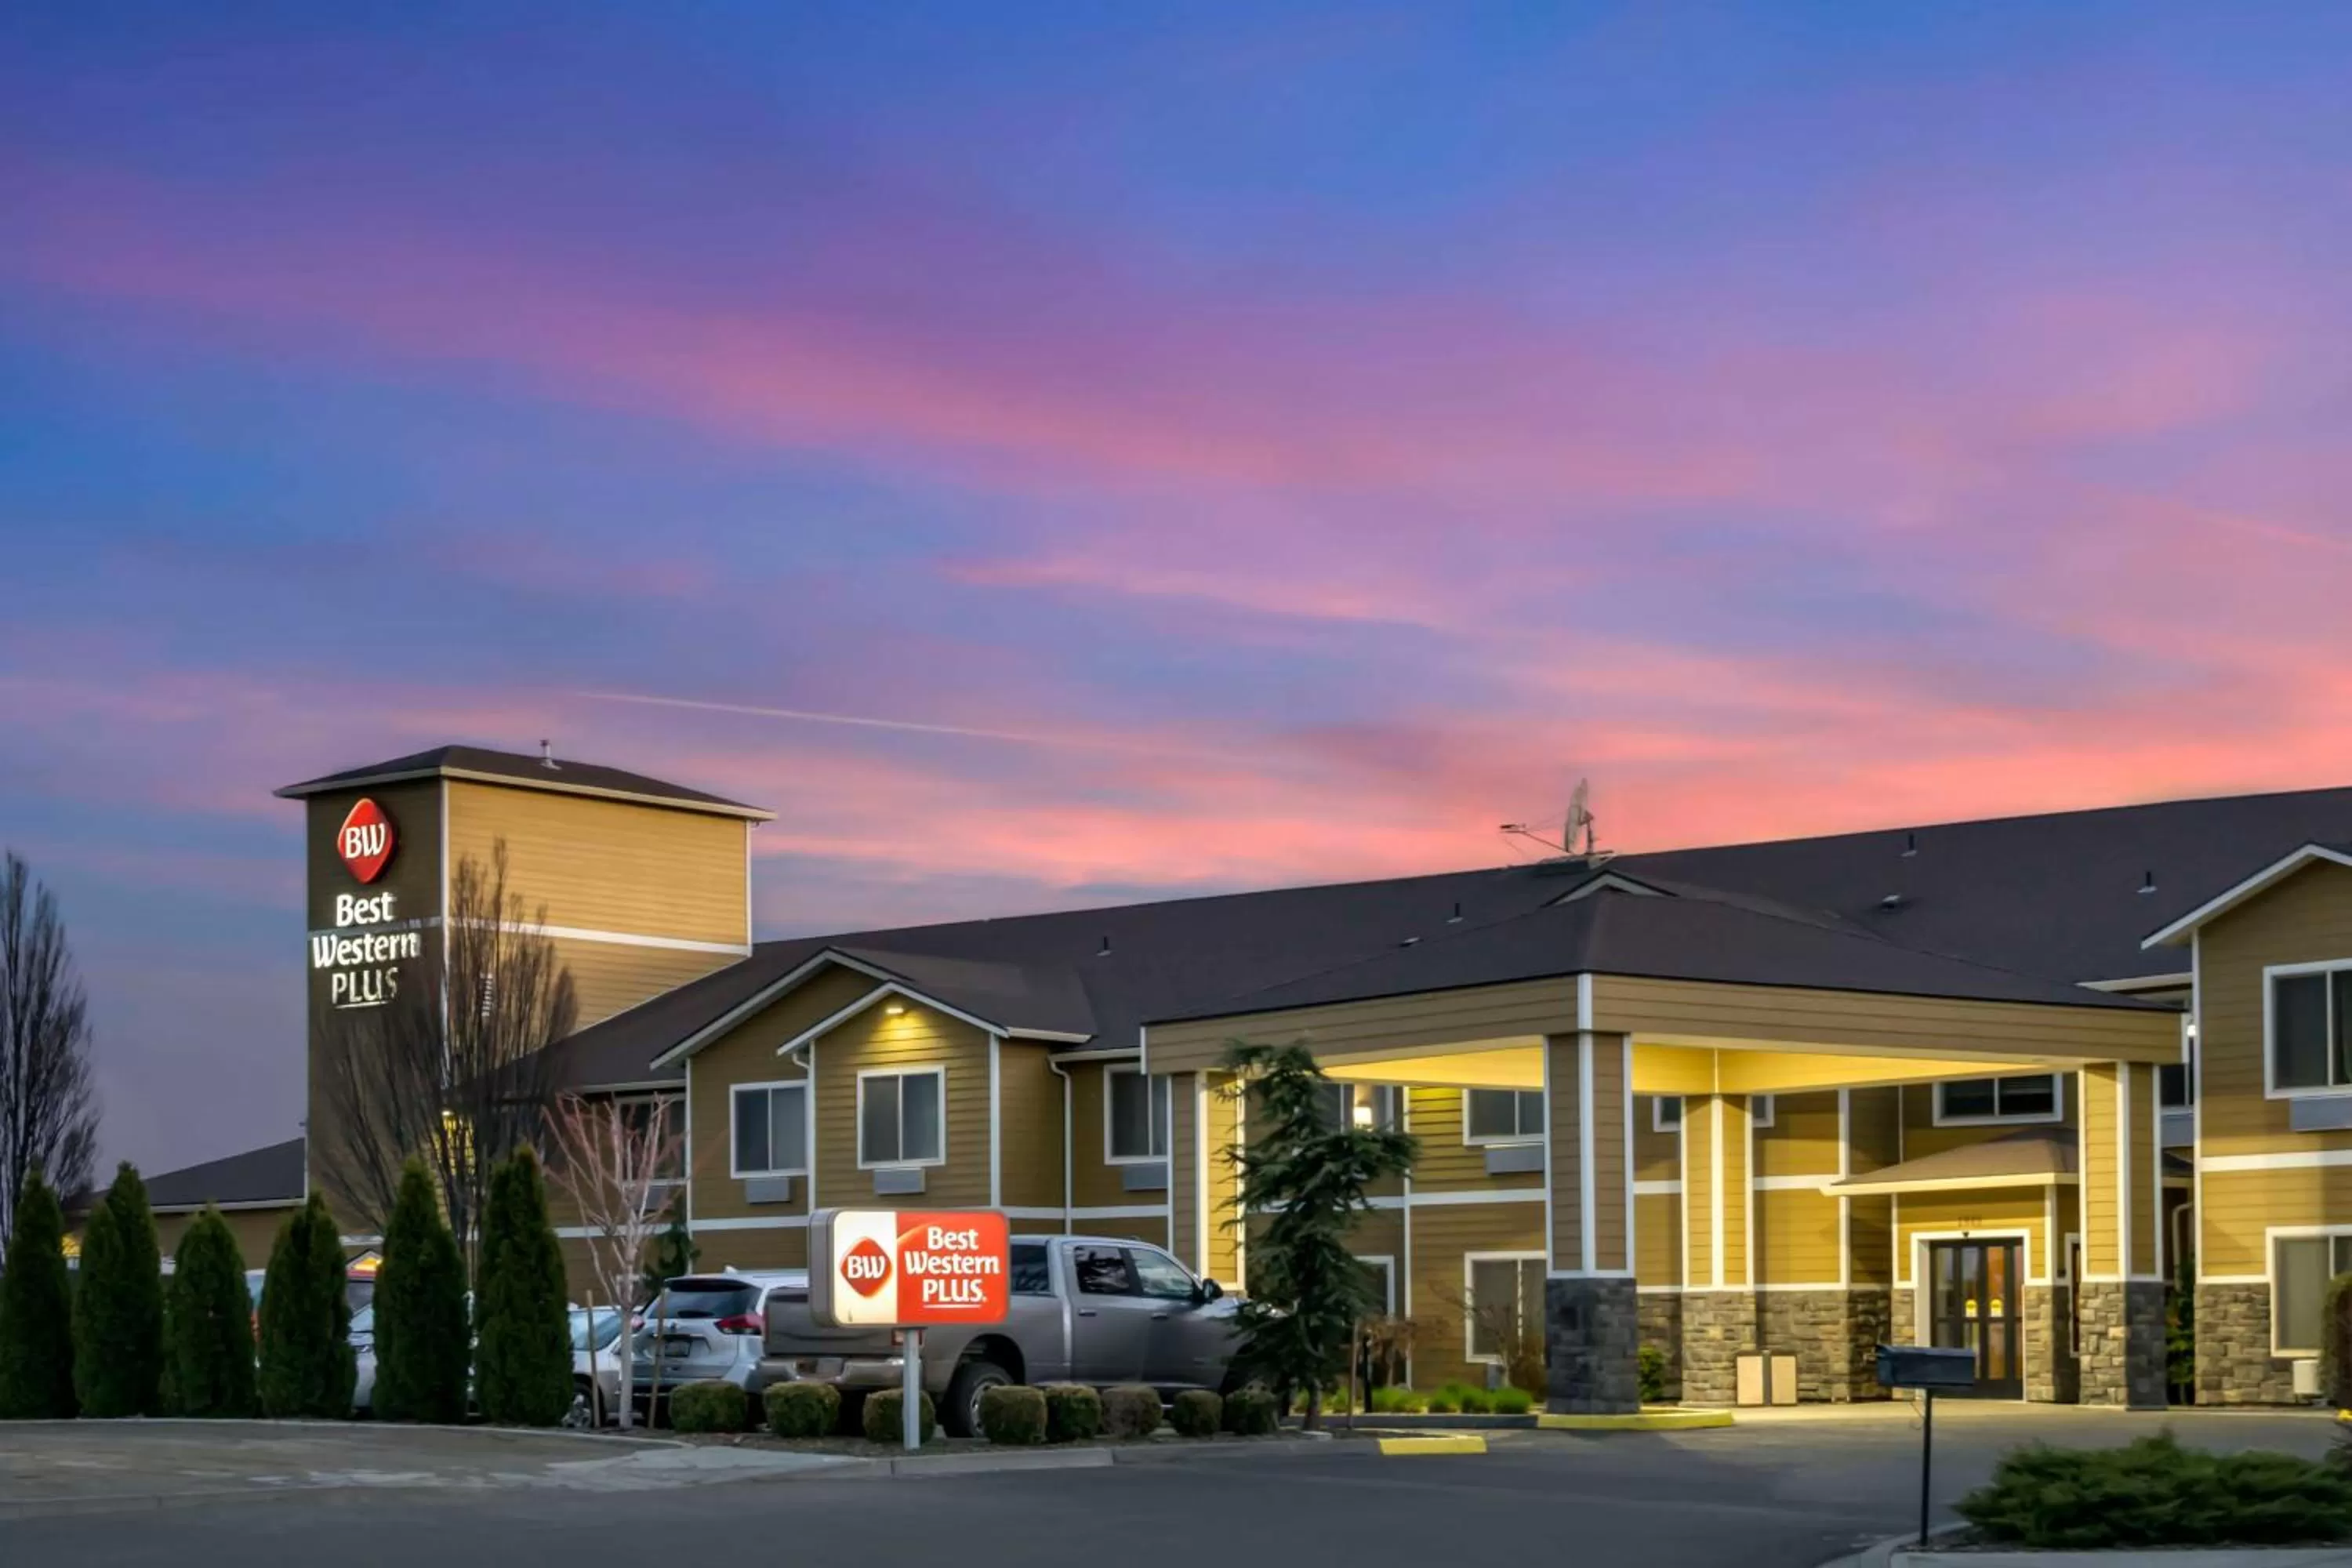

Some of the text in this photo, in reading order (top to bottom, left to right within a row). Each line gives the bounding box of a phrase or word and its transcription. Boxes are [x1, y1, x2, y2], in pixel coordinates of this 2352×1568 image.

[345, 823, 386, 858] BW
[336, 891, 394, 927] Best
[313, 932, 419, 968] Western
[332, 967, 398, 1004] PLUS
[927, 1226, 979, 1250] Best
[848, 1255, 886, 1279] BW
[904, 1251, 1000, 1275] Western
[923, 1279, 983, 1302] PLUS
